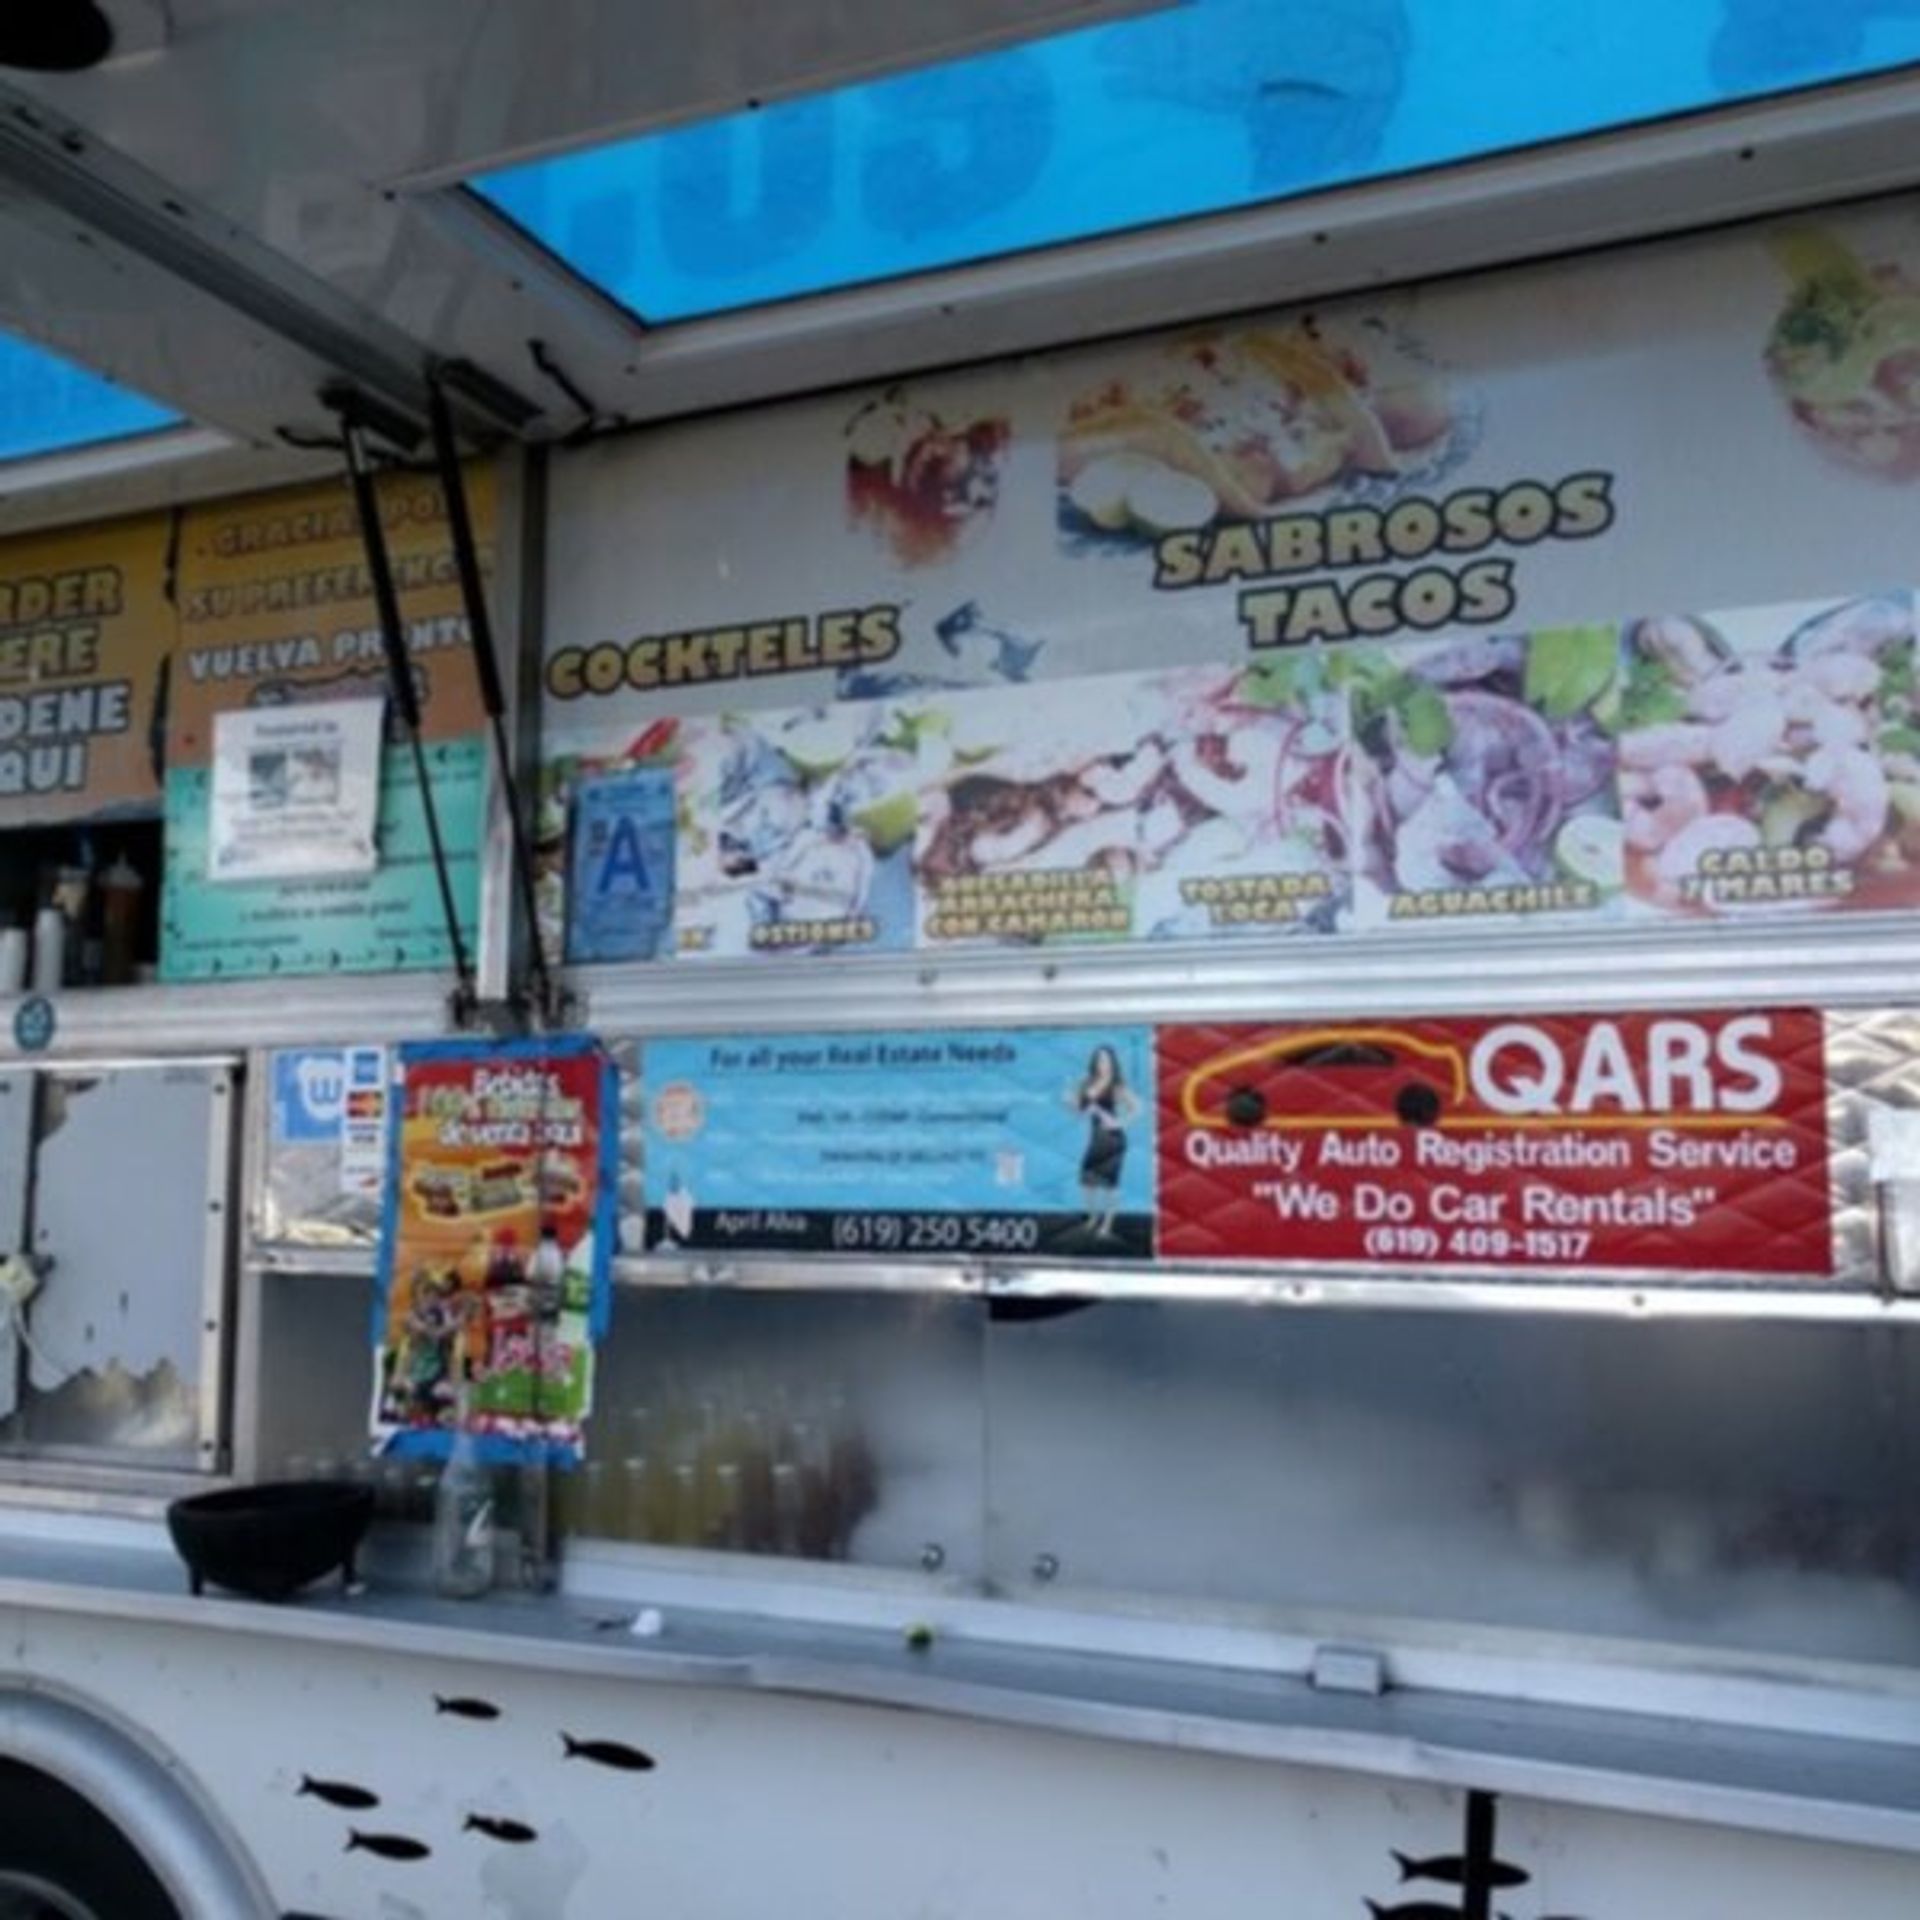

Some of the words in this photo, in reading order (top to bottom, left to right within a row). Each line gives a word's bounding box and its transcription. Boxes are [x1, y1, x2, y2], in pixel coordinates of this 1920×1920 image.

[214, 514, 362, 556] GRACIA
[1153, 471, 1614, 590] SABROSOS
[1238, 557, 1517, 650] TACOS
[188, 636, 322, 682] VUELVA
[332, 615, 474, 662] PRNT
[546, 603, 902, 698] COCKTELES
[597, 815, 651, 893] A
[1697, 845, 1833, 877] CALDO
[1178, 872, 1331, 902] TOSTADA
[1387, 882, 1598, 919] AGUACHILE
[1712, 868, 1854, 902] MARES
[1210, 897, 1296, 926] LOCA
[709, 1046, 743, 1069] For
[747, 1045, 772, 1068] all
[827, 1043, 873, 1066] Real
[876, 1042, 943, 1066] Estate
[946, 1041, 1017, 1064] Needs
[1469, 1017, 1781, 1116] QARS
[1186, 1130, 1303, 1171] Quality
[1319, 1131, 1399, 1167] Auto
[1416, 1131, 1631, 1170] Registration
[1648, 1131, 1797, 1169] Service
[1354, 1186, 1413, 1222] Do
[1429, 1187, 1507, 1223] Car
[831, 1217, 900, 1247] (619)
[906, 1217, 962, 1247] 250
[966, 1218, 1039, 1249] 5400
[1364, 1228, 1440, 1257] (619)
